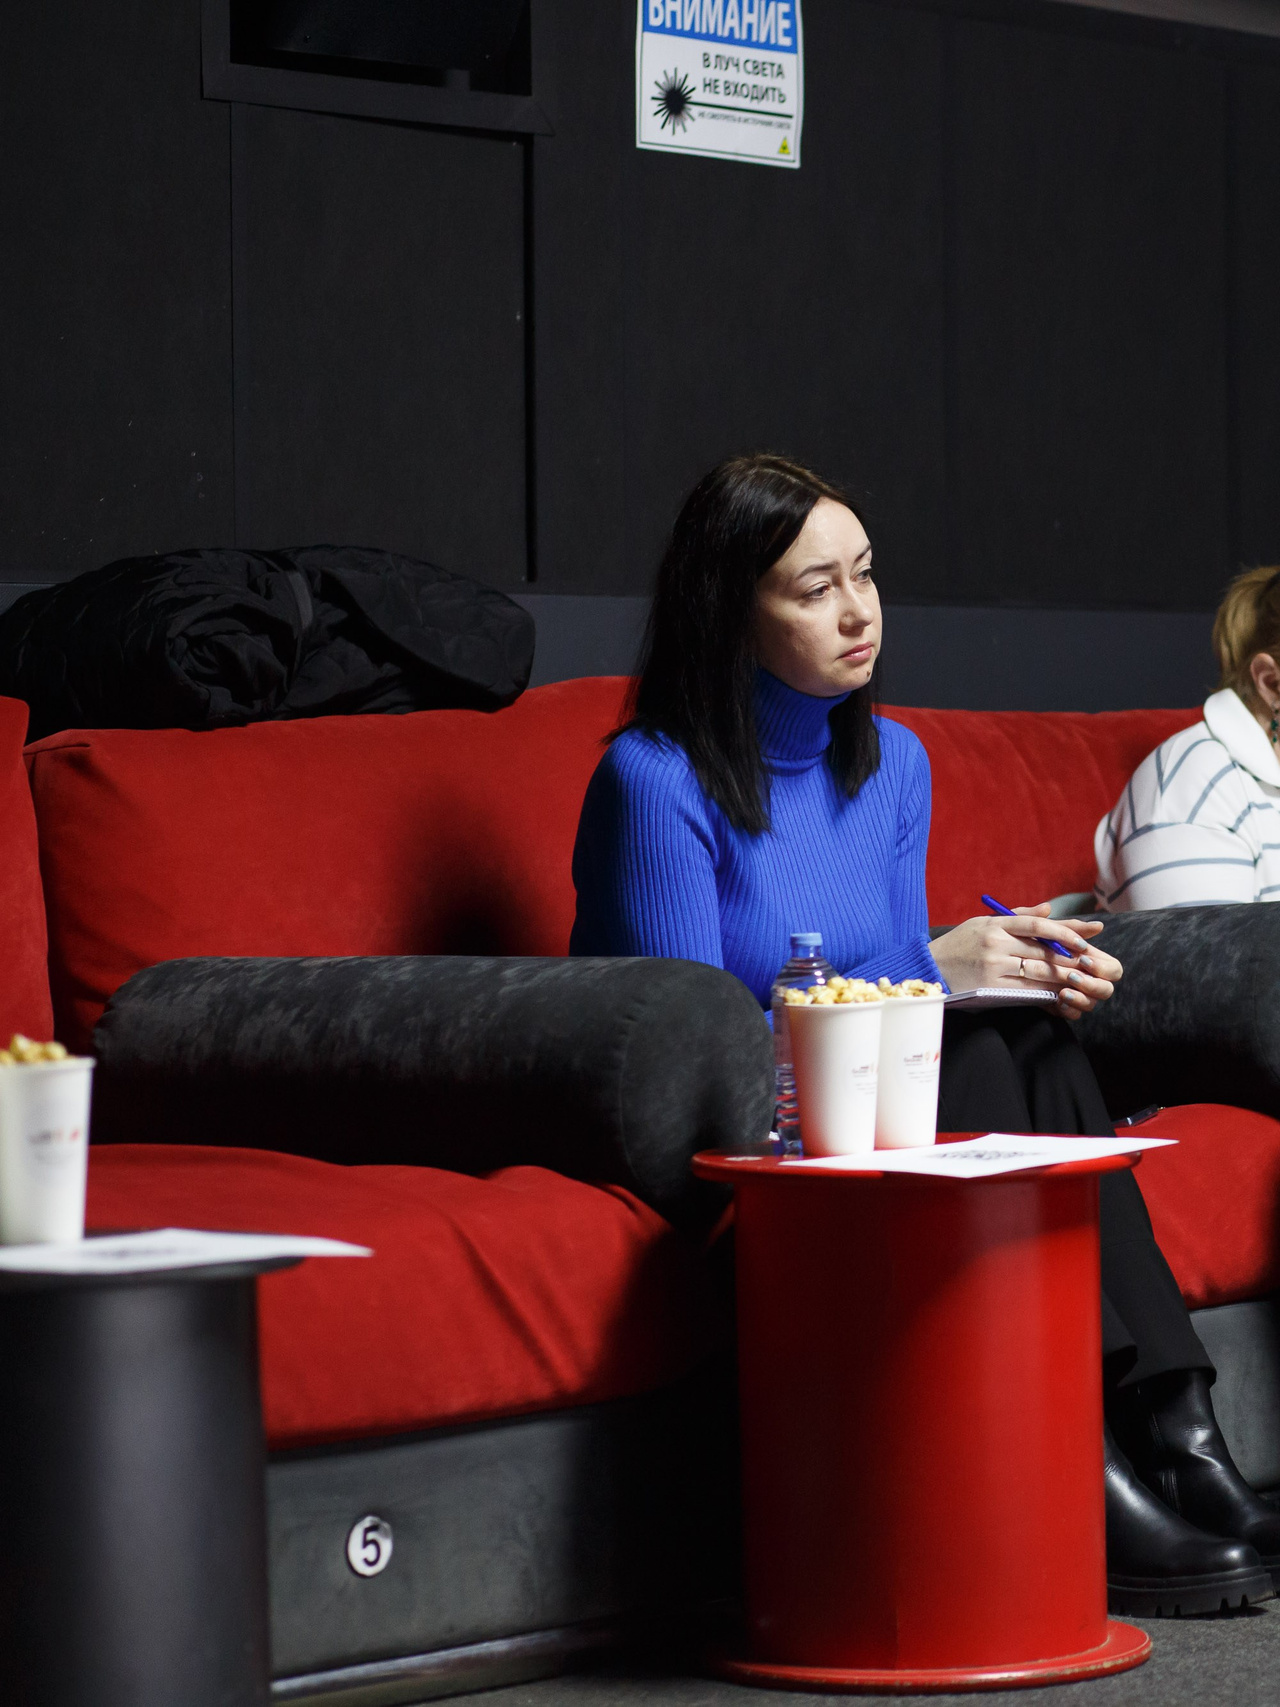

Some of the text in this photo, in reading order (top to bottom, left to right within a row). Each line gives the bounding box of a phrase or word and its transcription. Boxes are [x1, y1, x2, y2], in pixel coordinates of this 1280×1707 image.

[648, 0, 792, 47] ВНИМАНИЕ
[702, 52, 785, 79] В ЛУЧ СВЕТА
[703, 78, 786, 104] НЕ ВХОДИТЬ
[362, 1524, 381, 1567] 5
